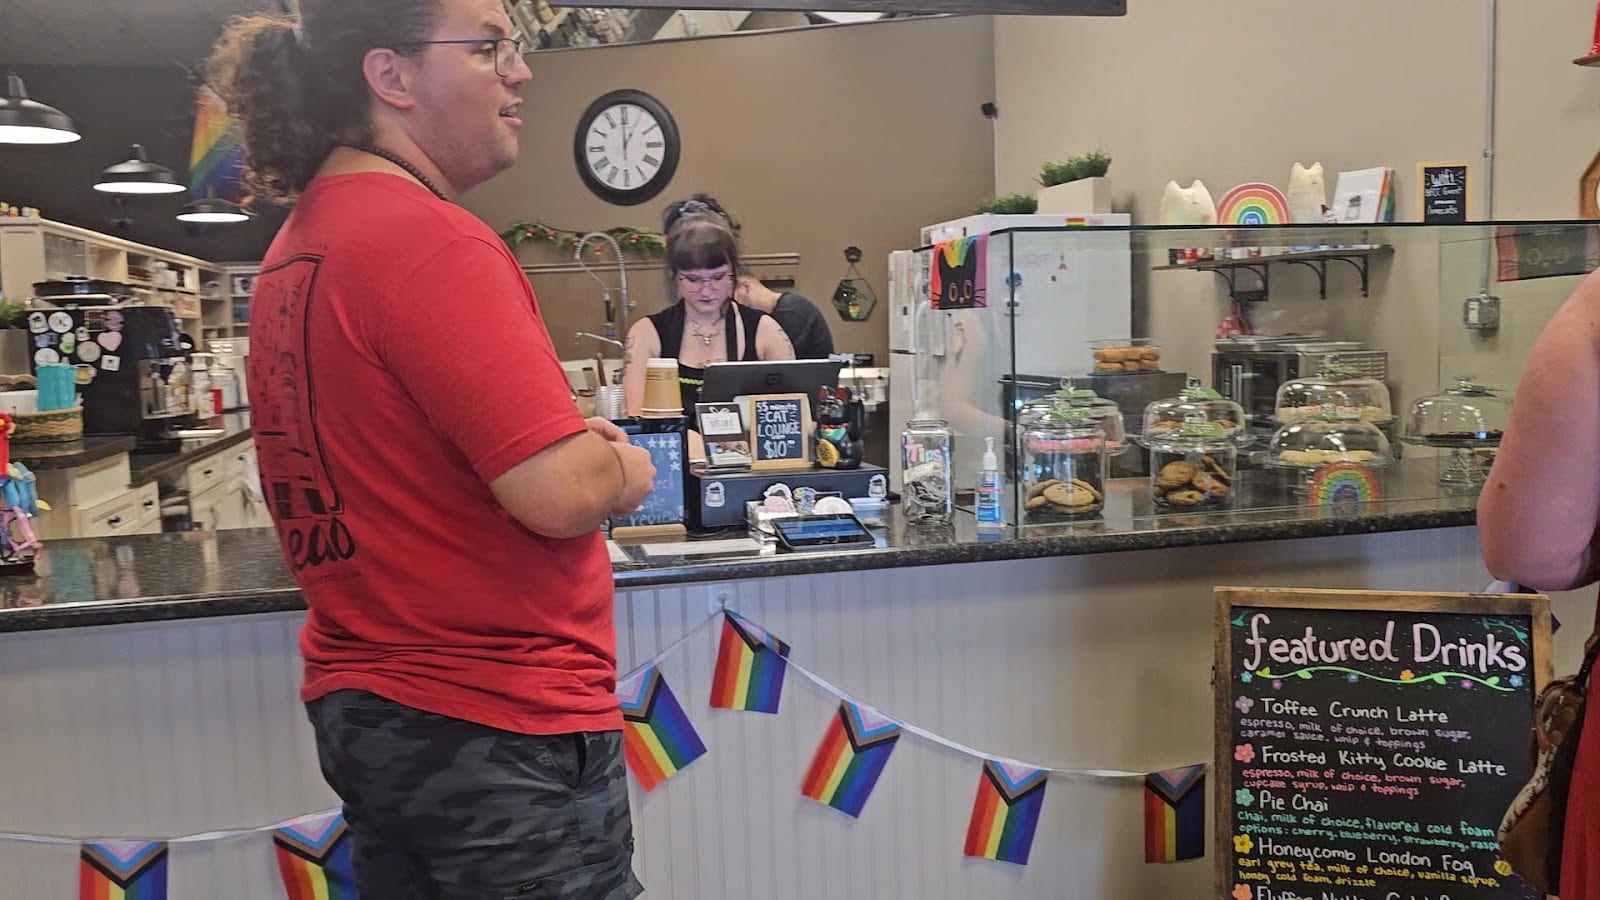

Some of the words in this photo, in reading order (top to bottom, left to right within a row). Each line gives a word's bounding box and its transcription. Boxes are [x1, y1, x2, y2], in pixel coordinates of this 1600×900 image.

[765, 411, 789, 423] CAT
[757, 422, 802, 438] LOUNGE
[1243, 613, 1399, 671] featured
[1412, 622, 1527, 674] Drinks
[1260, 698, 1319, 716] Toffee
[1329, 701, 1389, 719] Crunch
[1396, 706, 1449, 723] Latte
[1240, 729, 1286, 739] caramel
[1334, 735, 1359, 745] whip
[1375, 738, 1426, 753] toppings
[1299, 722, 1322, 732] milk
[1330, 723, 1343, 733] of
[1389, 726, 1429, 737] brown
[1262, 745, 1327, 764] Frosted
[1338, 750, 1387, 771] Kitty
[1393, 753, 1448, 771] Cookie
[1458, 759, 1508, 776] Latte
[1297, 768, 1319, 779] milk
[1323, 768, 1336, 779] of
[1385, 773, 1422, 784] brown
[1243, 780, 1287, 789] cupcake
[1331, 783, 1355, 792] whip
[1370, 783, 1420, 800] toppings
[1260, 789, 1286, 811] Pie
[1292, 793, 1329, 812] Chai
[1238, 823, 1288, 834] options:
[1271, 812, 1297, 824] milk
[1302, 814, 1316, 825] of
[1365, 816, 1420, 833] flavored
[1427, 824, 1453, 835] cold
[1460, 820, 1496, 837] foam
[1258, 837, 1356, 863] Honeycomb
[1366, 847, 1431, 867] London
[1441, 854, 1476, 878] Fog
[1238, 858, 1260, 867] earl
[1266, 859, 1296, 873] grey
[1327, 863, 1352, 874] milk
[1355, 864, 1369, 874] of
[1417, 870, 1457, 881] vanilla
[1239, 870, 1271, 885] honey
[1275, 873, 1297, 882] cold
[1335, 876, 1376, 888] drizzle
